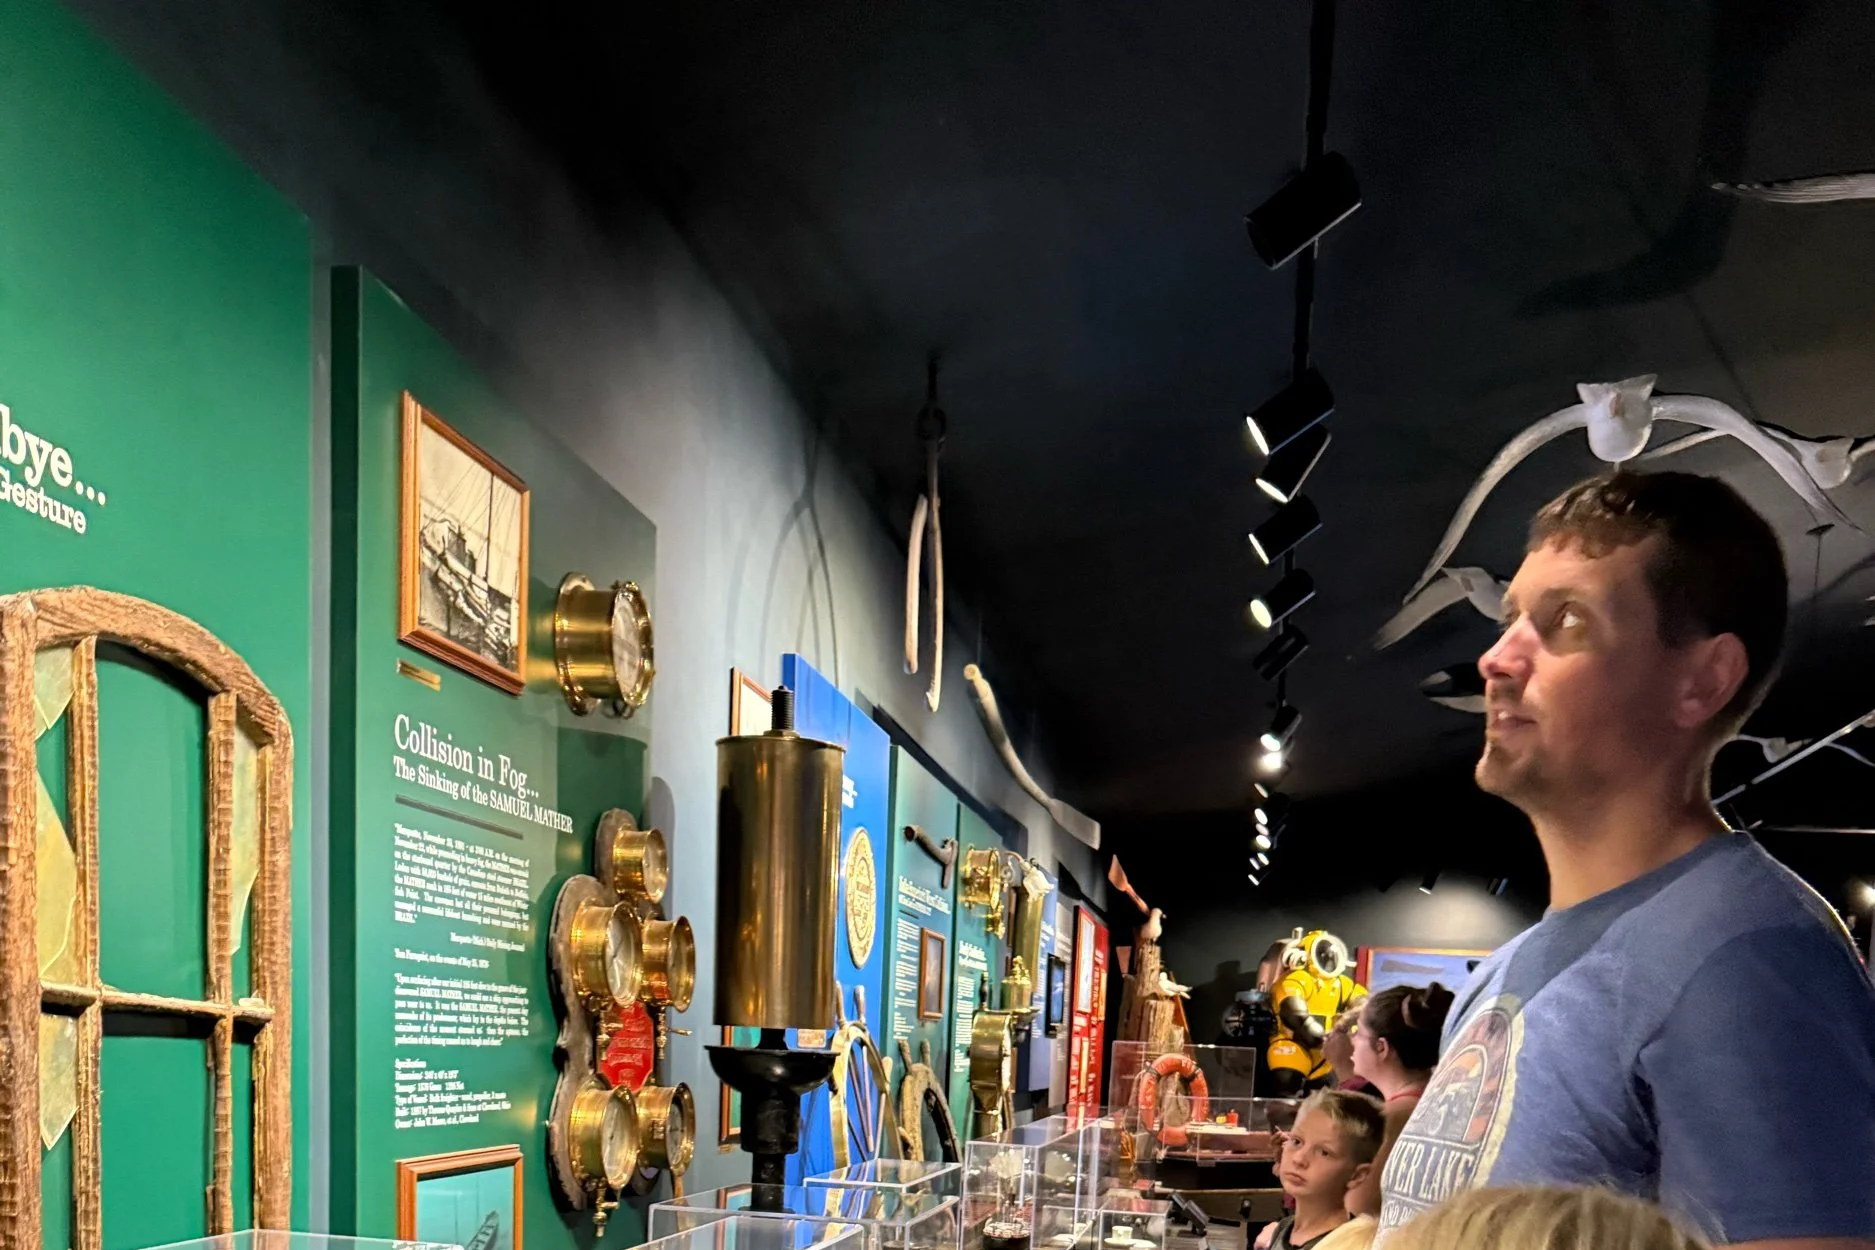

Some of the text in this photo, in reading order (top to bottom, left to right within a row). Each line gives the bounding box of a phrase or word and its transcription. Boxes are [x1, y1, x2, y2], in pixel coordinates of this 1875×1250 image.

[393, 755, 573, 834] The Sinking of the SAMUEL MATHER
[394, 714, 539, 798] Collision in Fog...
